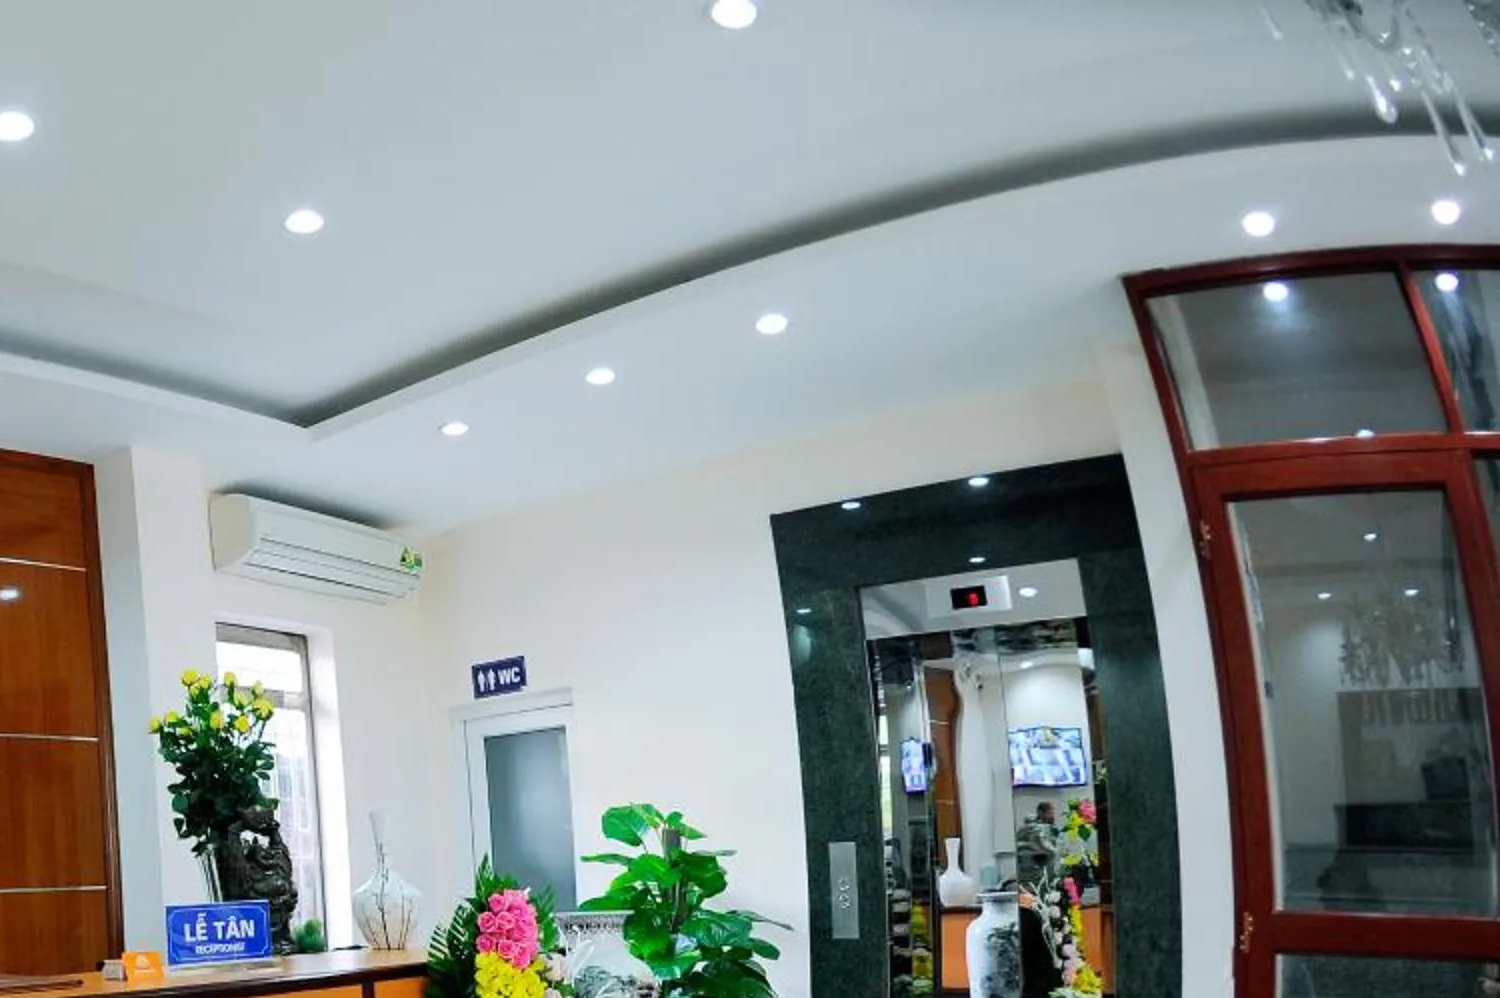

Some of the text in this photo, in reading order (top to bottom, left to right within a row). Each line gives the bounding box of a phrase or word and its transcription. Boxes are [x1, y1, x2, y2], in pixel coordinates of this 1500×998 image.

[497, 666, 521, 685] WC
[183, 912, 255, 942] LỄ TÂN
